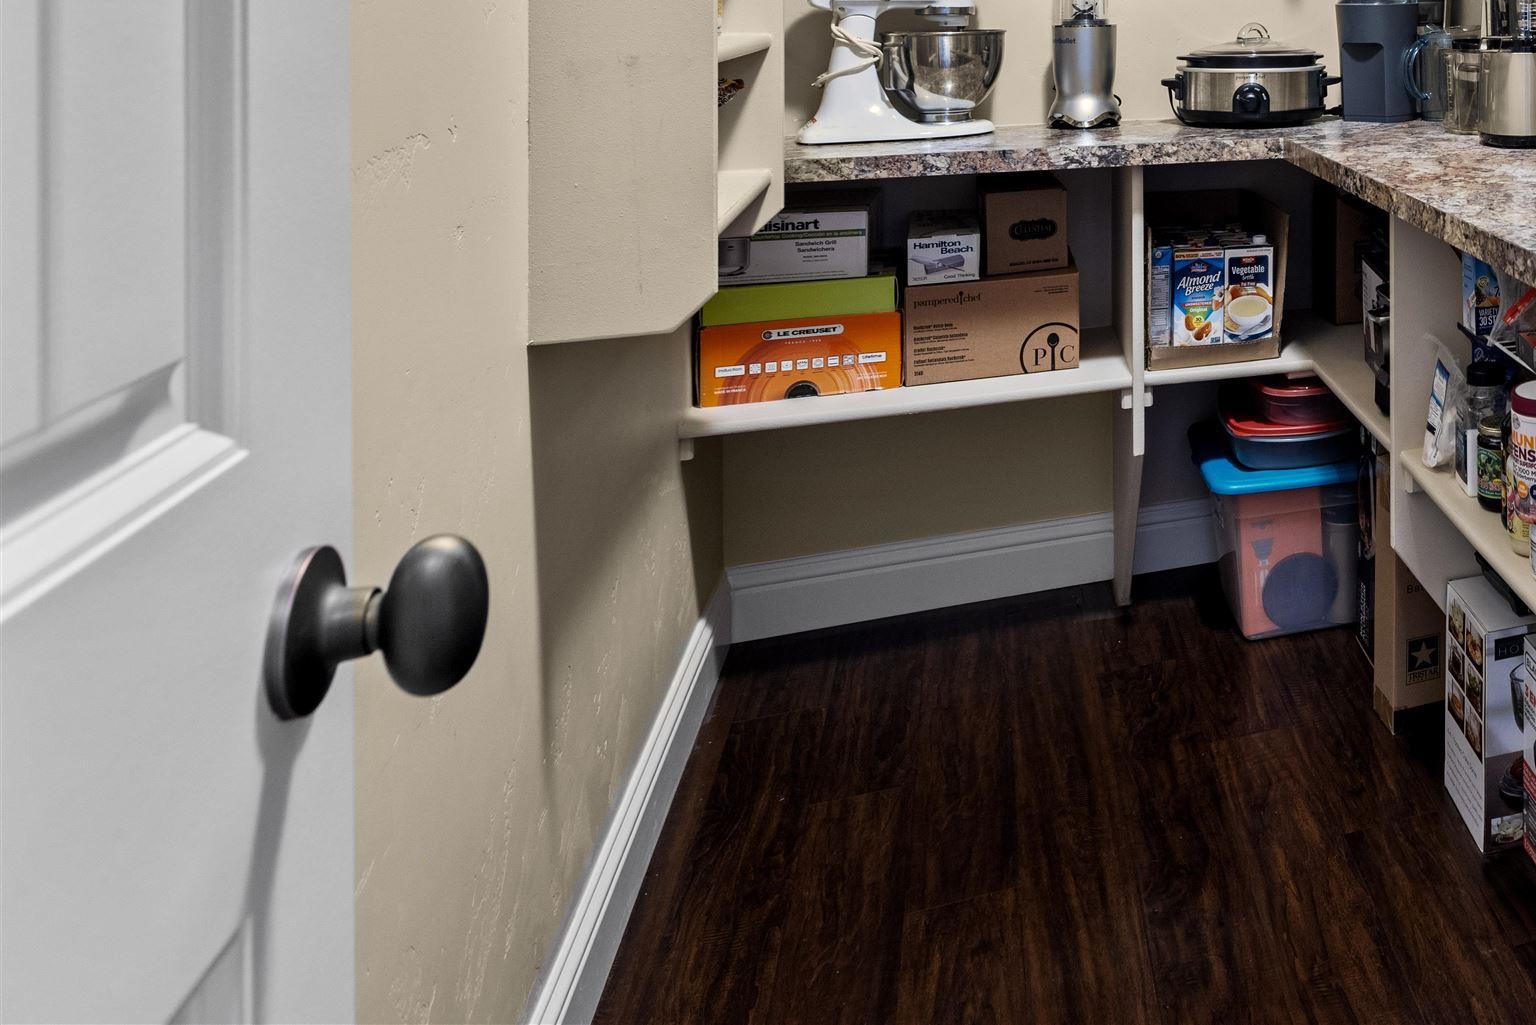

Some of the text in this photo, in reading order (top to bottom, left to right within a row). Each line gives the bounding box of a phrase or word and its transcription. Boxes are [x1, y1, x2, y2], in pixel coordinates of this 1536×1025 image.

[913, 239, 962, 251] Hamilton
[940, 245, 974, 255] Beach
[1231, 264, 1265, 276] Vegetable
[1176, 270, 1222, 290] Almond
[1184, 281, 1215, 296] Breeze
[913, 292, 981, 309] pampered chef
[1479, 315, 1498, 327] 30 ST
[776, 326, 837, 337] LE CREUSET
[1032, 344, 1075, 367] P C
